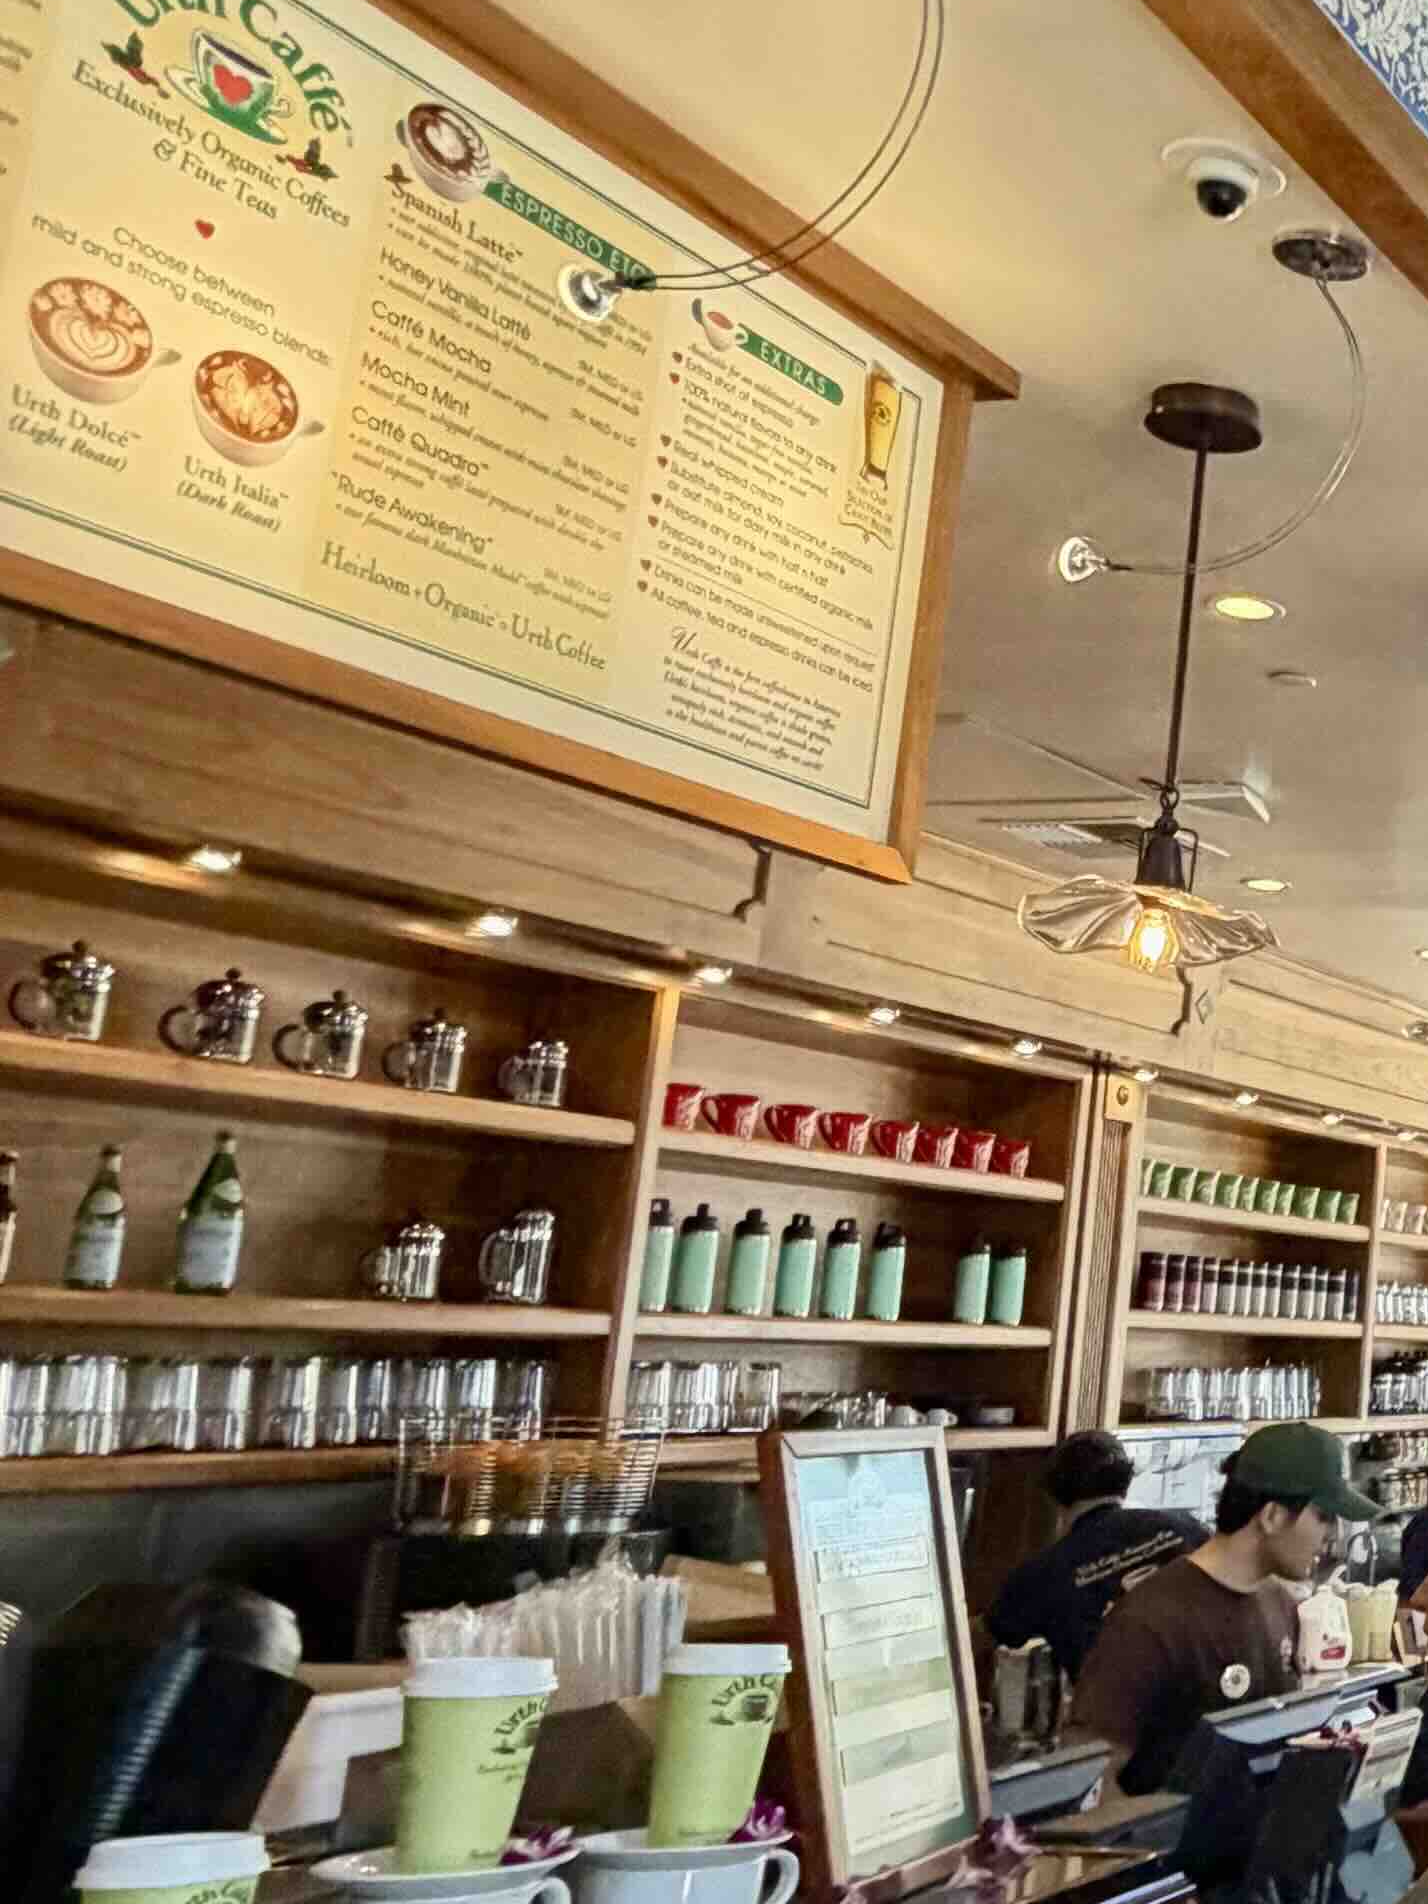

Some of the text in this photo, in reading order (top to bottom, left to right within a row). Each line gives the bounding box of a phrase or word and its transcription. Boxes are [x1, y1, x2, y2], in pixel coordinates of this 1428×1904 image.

[73, 60, 349, 227] Exclusively Organic Coffees
[152, 138, 277, 219] & Fine Teas
[391, 179, 463, 234] Spanish
[501, 182, 603, 258] ESPRESSO
[32, 215, 78, 246] mild
[81, 239, 124, 268] and
[127, 261, 187, 302] strong
[191, 292, 269, 337] espresso
[113, 227, 275, 316] Choose between
[380, 248, 436, 291] Honey
[438, 278, 490, 320] Vanilla
[428, 328, 492, 374] Mocha
[759, 342, 826, 396] EXTRAS
[13, 385, 61, 421] Urth
[361, 352, 470, 417] Mocha Mint
[12, 415, 127, 472] (Light Roast)
[184, 455, 227, 488] Urth
[177, 481, 281, 532] (Dark Roast)
[321, 541, 410, 596] Heirloom
[511, 613, 553, 650] Urth
[555, 633, 605, 670] Coffee
